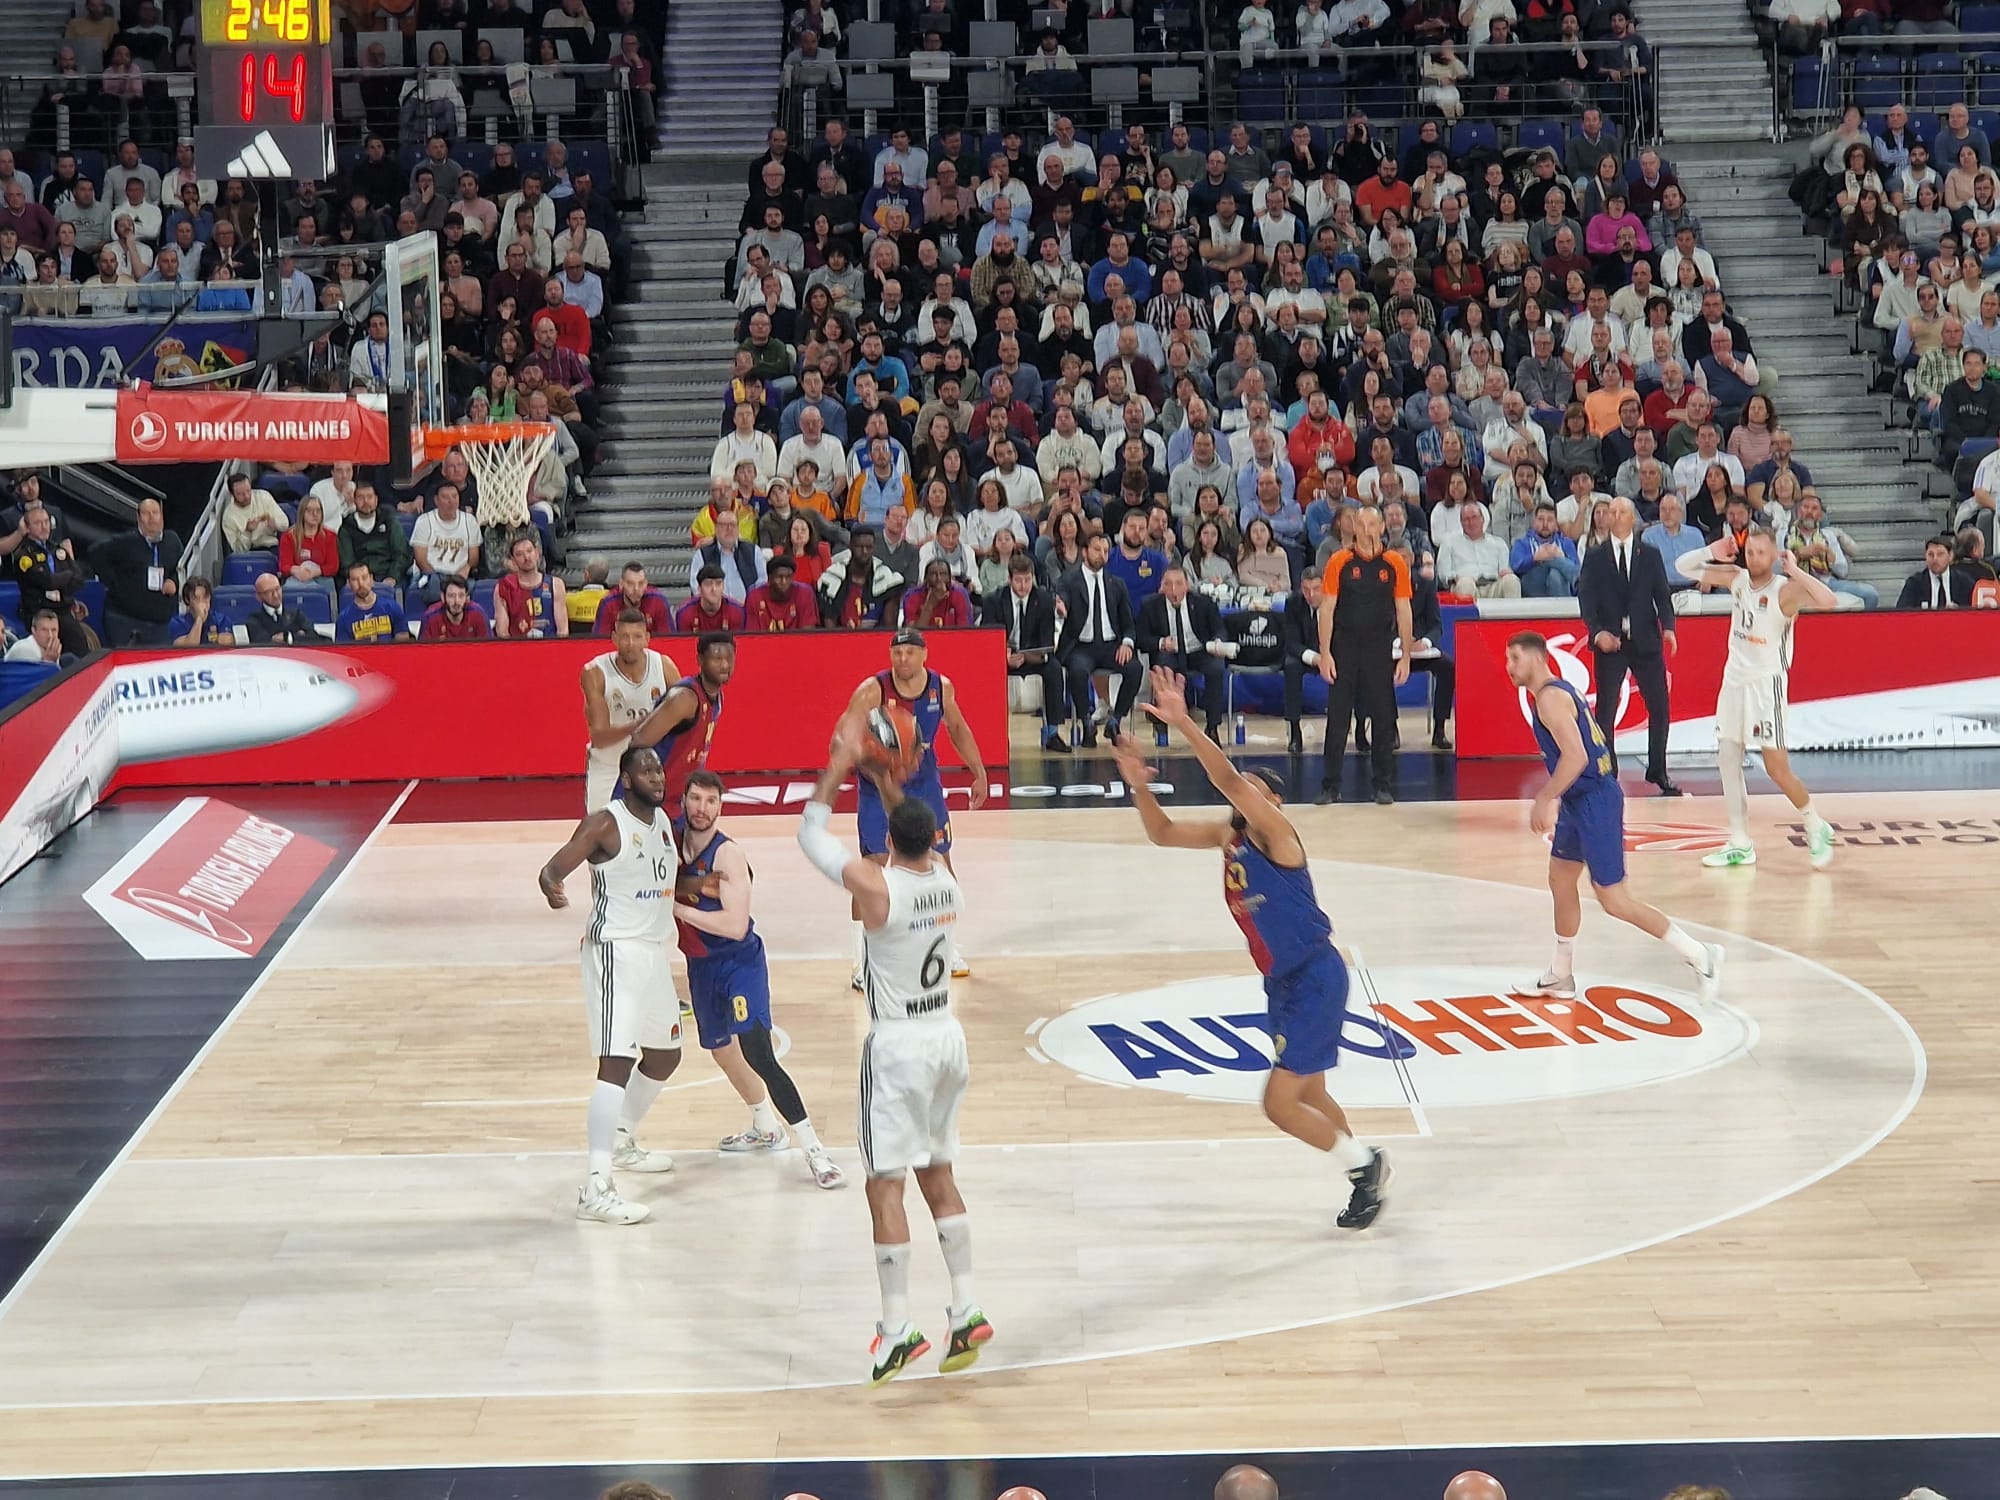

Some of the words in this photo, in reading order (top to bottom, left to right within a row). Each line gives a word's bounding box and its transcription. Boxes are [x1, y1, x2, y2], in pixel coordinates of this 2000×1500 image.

[227, 0, 309, 40] 2:46
[241, 53, 304, 121] 14
[175, 421, 259, 441] TURKISH
[265, 420, 350, 440] AIRLINES
[1741, 609, 1754, 630] 13
[1238, 633, 1277, 648] Unicaja
[1760, 720, 1773, 740] 13
[219, 815, 295, 874] AIRLINES
[652, 856, 667, 882] 16
[178, 853, 261, 913] TURKISH
[920, 932, 946, 989] 6
[733, 995, 749, 1022] 8
